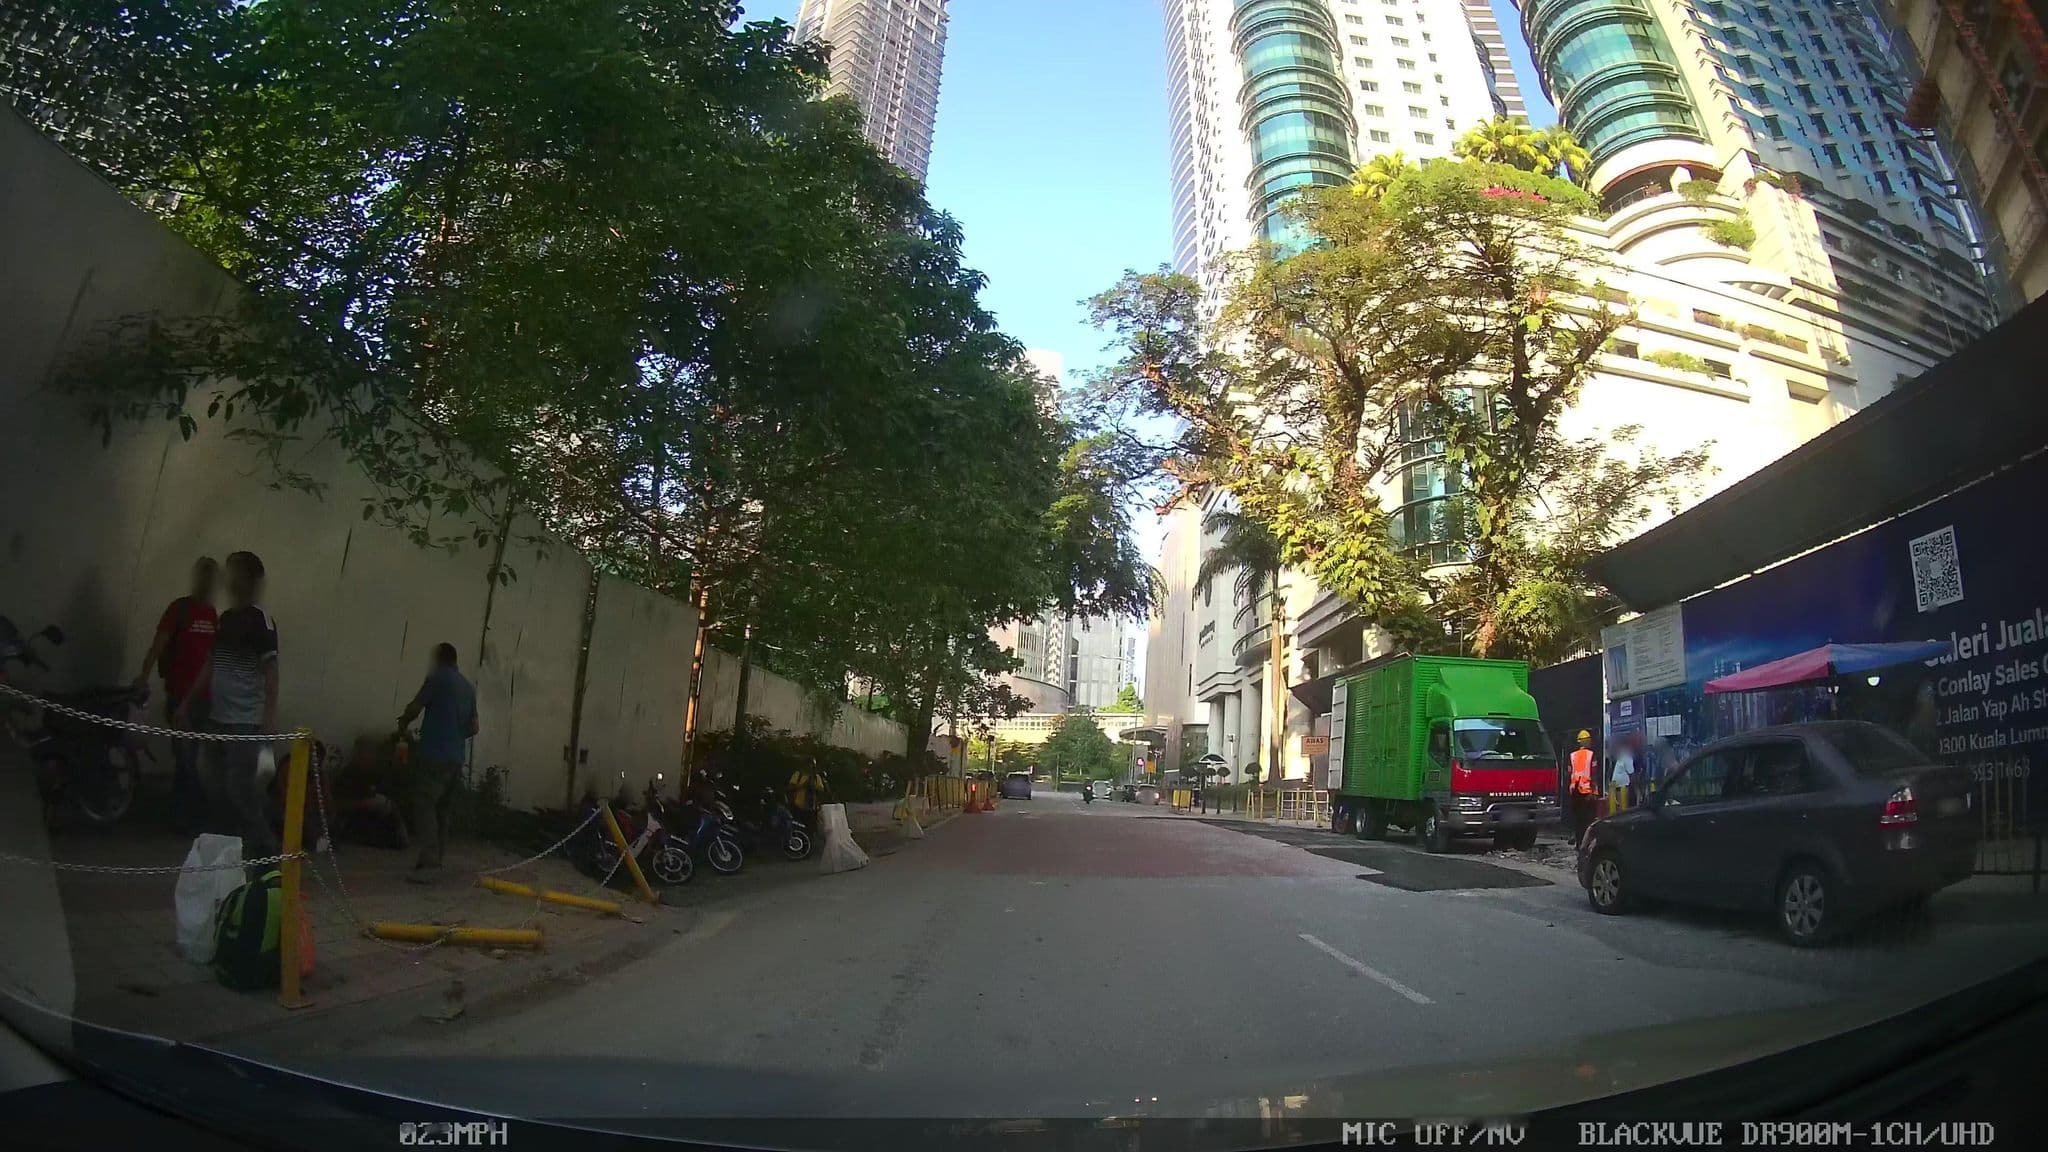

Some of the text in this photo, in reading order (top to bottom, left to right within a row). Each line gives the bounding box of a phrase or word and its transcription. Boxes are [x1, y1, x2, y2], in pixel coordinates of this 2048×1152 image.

[1938, 669, 1991, 696] Conlay
[1995, 659, 2039, 686] Sales
[1945, 703, 1979, 725] Jalan
[1982, 699, 2008, 721] Yap
[2011, 692, 2030, 713] Ah
[1969, 728, 2006, 750] Kuala
